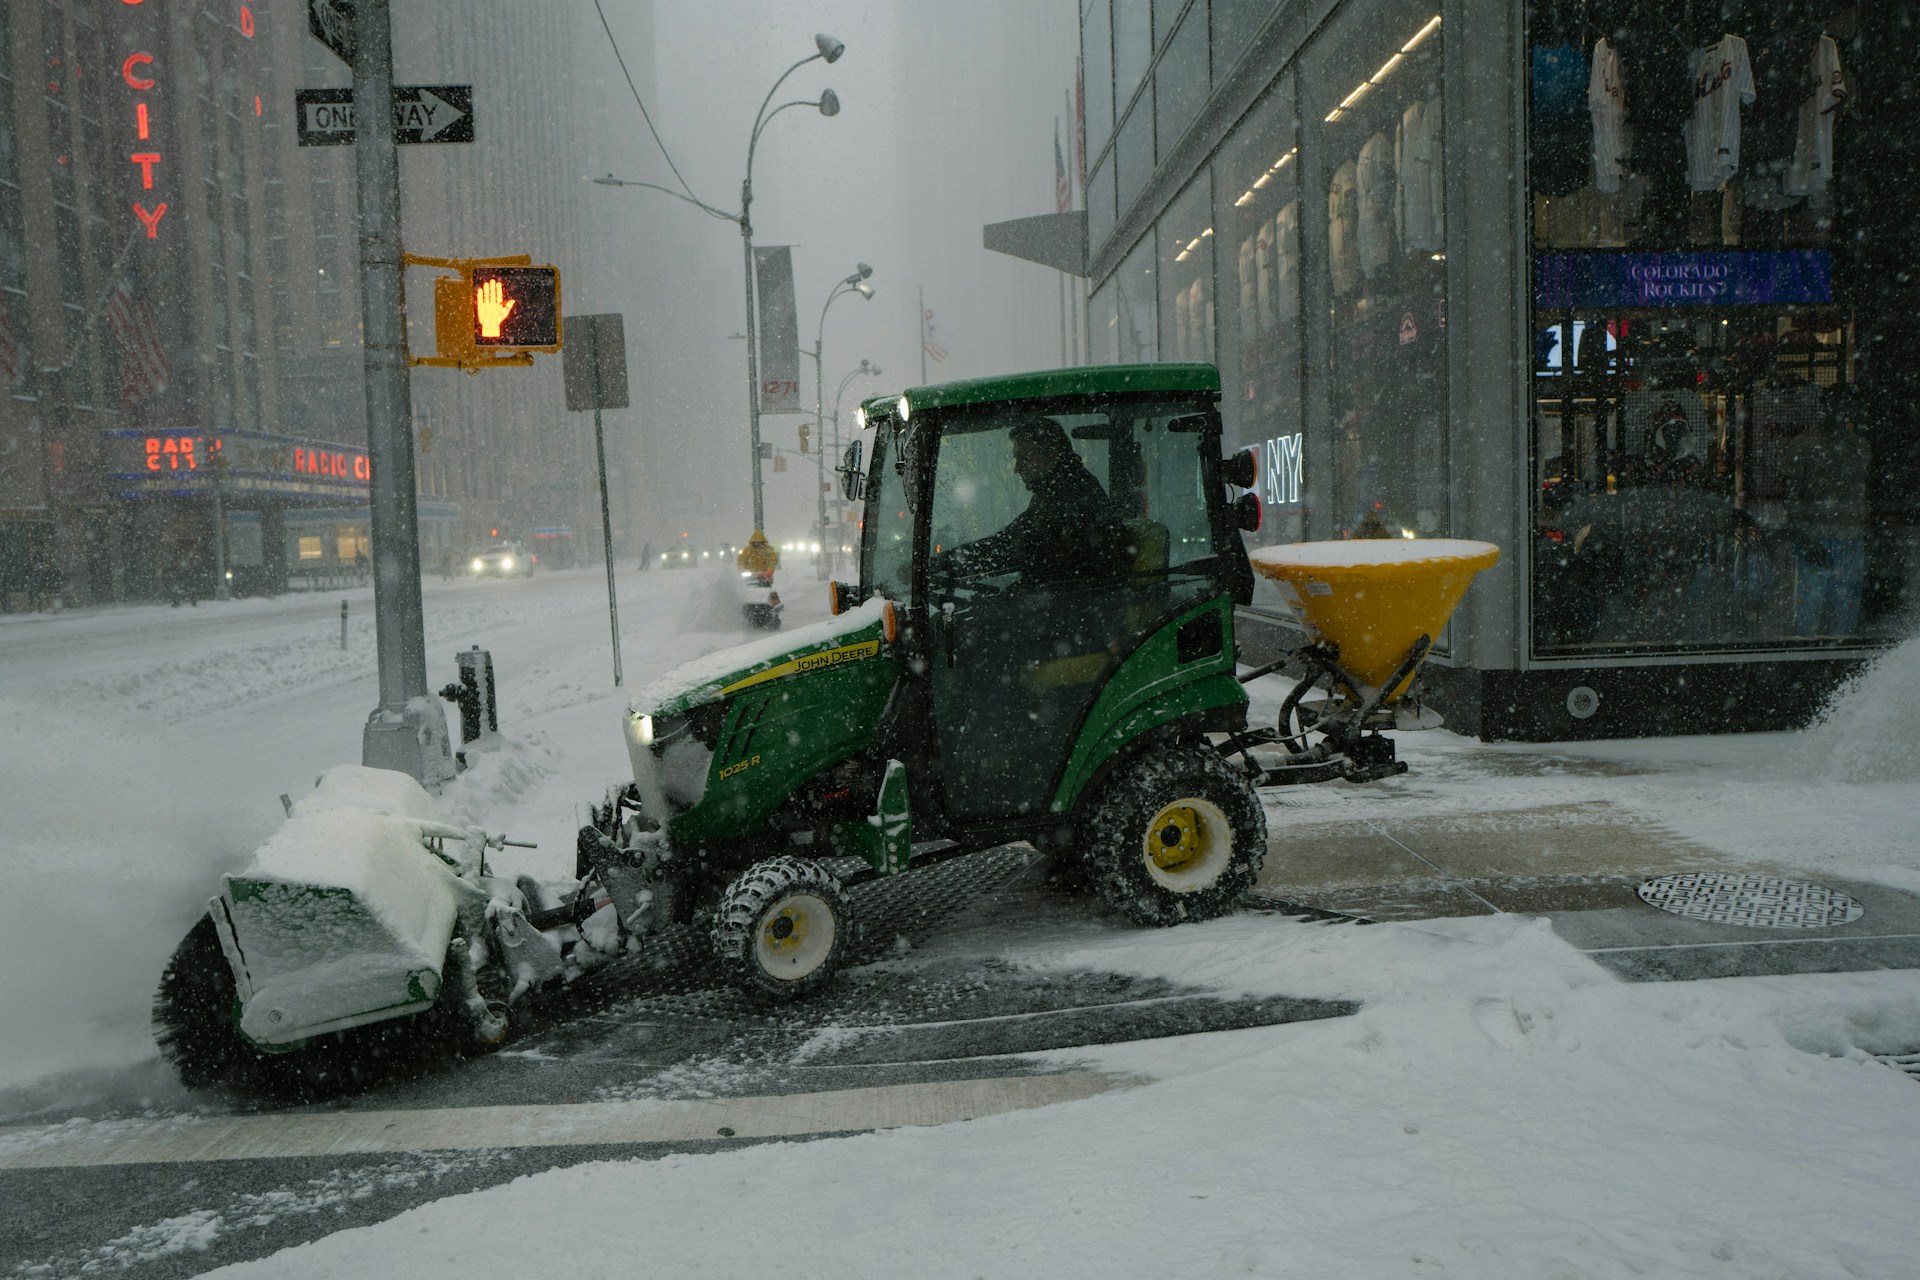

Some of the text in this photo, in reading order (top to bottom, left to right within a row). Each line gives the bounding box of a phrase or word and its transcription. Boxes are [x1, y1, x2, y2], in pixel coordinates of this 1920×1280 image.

[123, 53, 168, 239] CITY
[1631, 263, 1728, 279] COLORADO
[763, 380, 799, 397] 1271
[294, 447, 348, 478] RADIO
[1267, 432, 1303, 504] NY
[794, 646, 873, 673] JOHN DEERE
[719, 755, 761, 782] 1025 R
